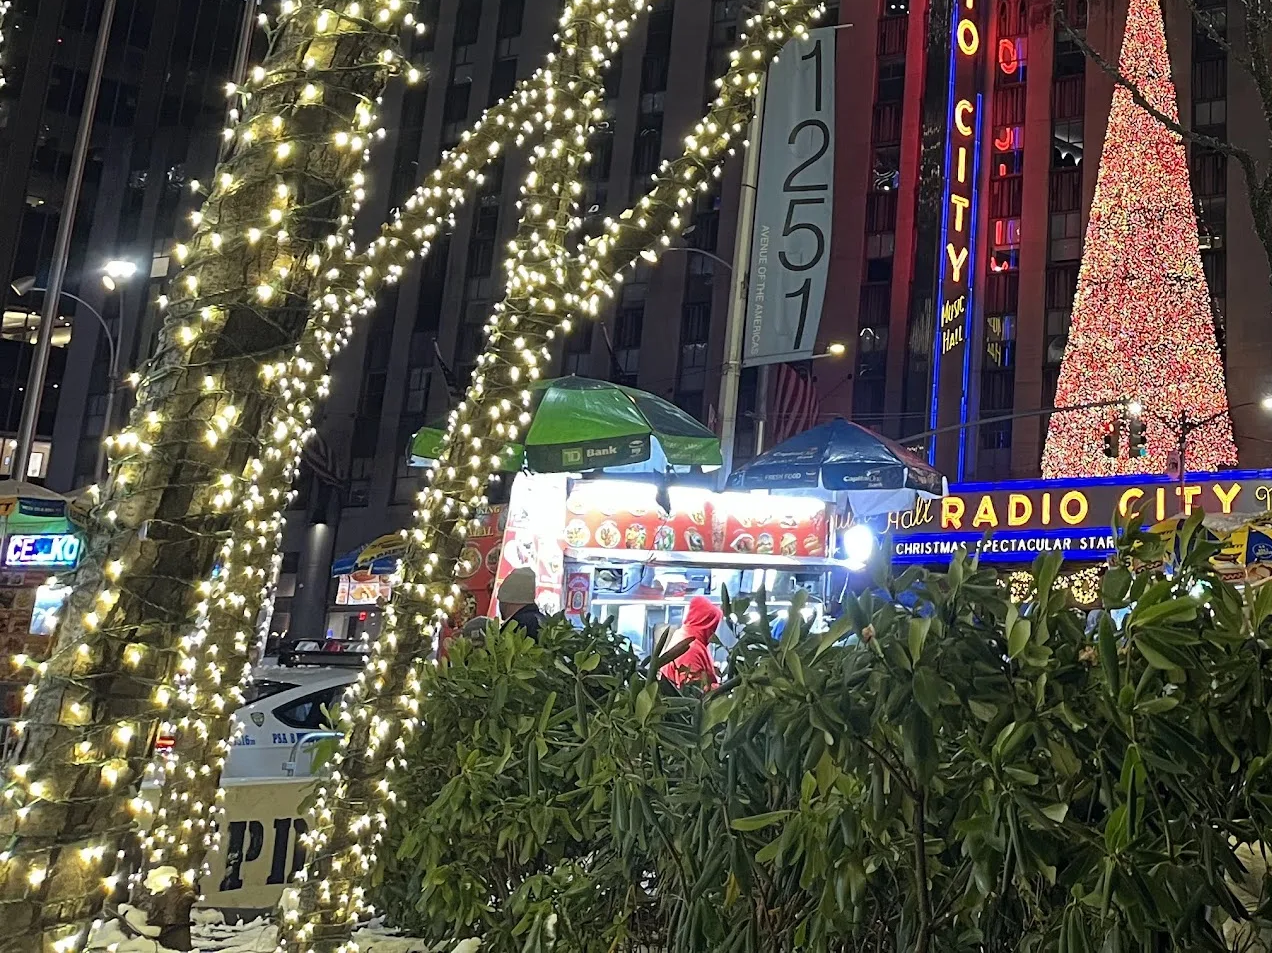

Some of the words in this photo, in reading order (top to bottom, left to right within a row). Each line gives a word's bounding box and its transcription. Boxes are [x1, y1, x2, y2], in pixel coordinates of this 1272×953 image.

[778, 40, 830, 350] 1251
[946, 99, 974, 282] CITY
[758, 225, 770, 264] AVENUE
[757, 266, 767, 280] OF
[755, 282, 766, 302] THE
[750, 303, 763, 355] AMERICAS
[942, 325, 964, 354] HALL
[586, 446, 618, 458] Bank
[941, 490, 1089, 530] RADIO
[1119, 483, 1242, 522] CITY
[895, 541, 967, 555] CHRISTMAS
[272, 733, 288, 744] PSA
